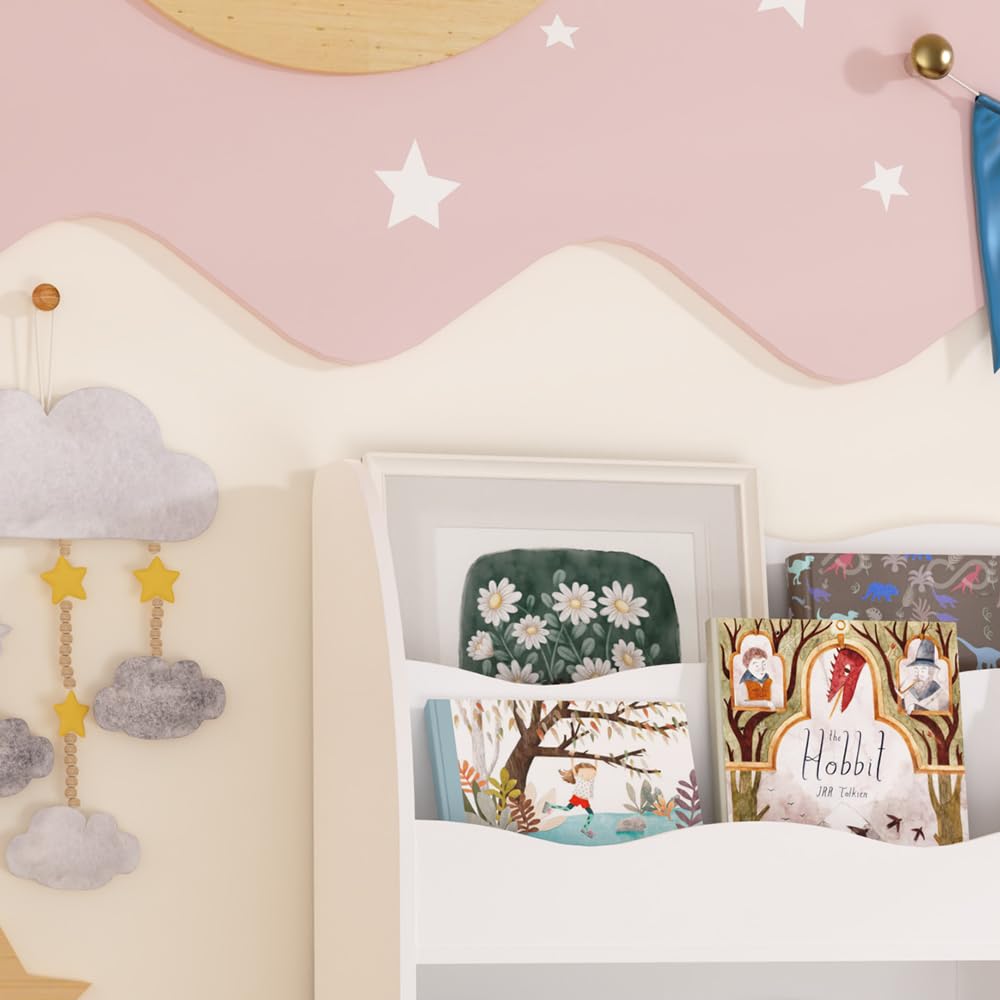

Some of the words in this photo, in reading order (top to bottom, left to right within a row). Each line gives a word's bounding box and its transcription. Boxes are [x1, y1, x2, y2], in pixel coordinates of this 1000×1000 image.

[829, 730, 841, 742] the
[802, 728, 885, 781] Hobbit
[816, 786, 833, 798] JRR
[840, 786, 868, 798] Tolkien
